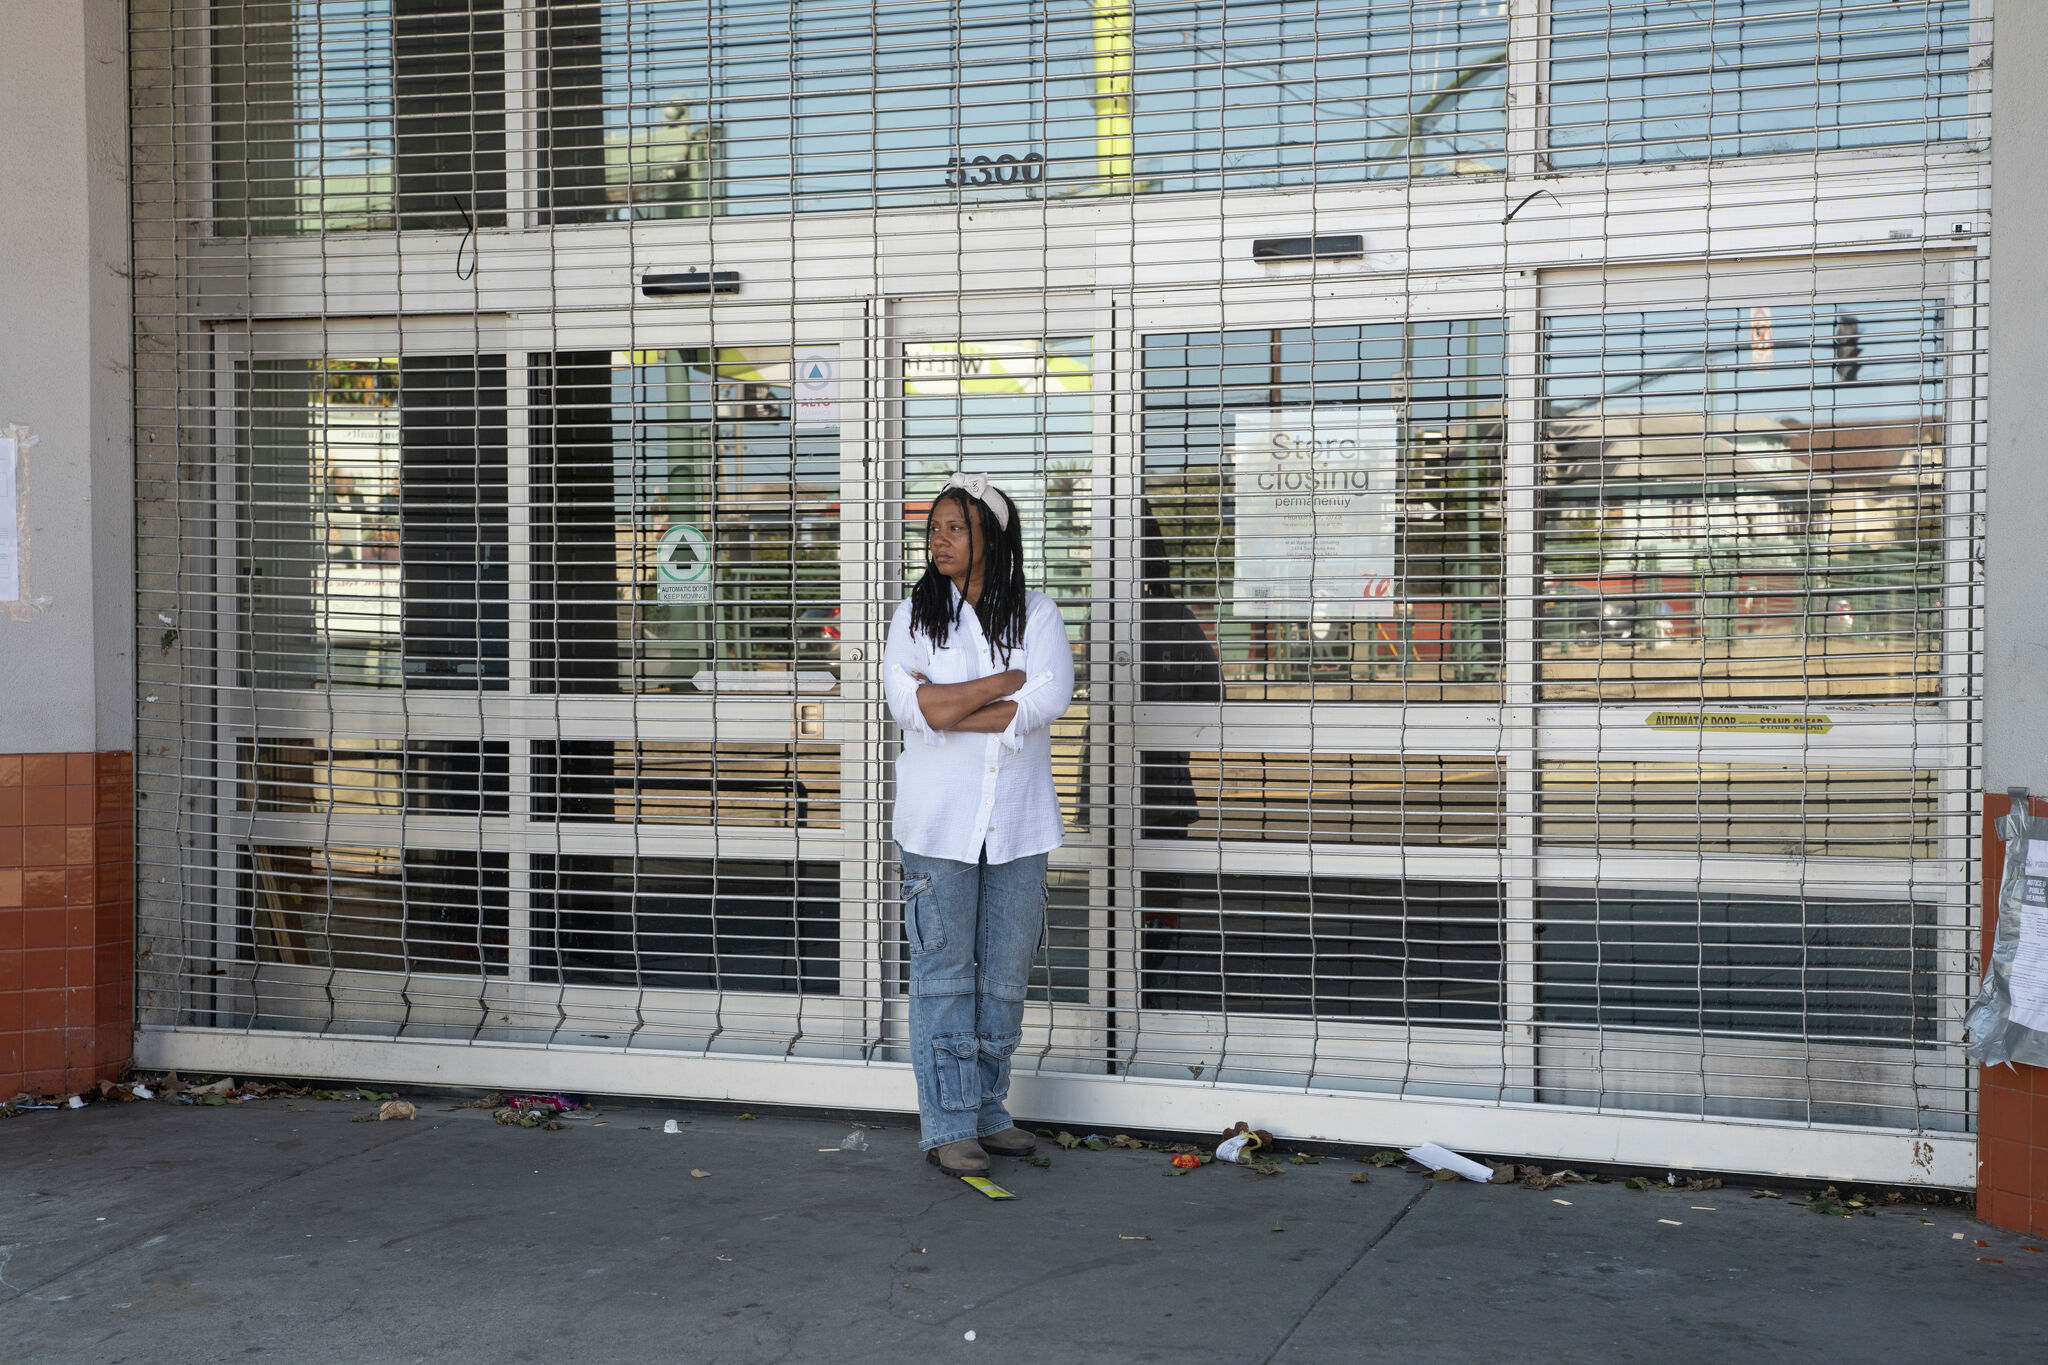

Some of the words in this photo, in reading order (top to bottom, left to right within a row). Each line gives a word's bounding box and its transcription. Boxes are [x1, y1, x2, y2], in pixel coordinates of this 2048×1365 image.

[944, 152, 1046, 188] 5300
[1273, 433, 1355, 460] Store
[1257, 464, 1369, 496] closing
[1655, 715, 1709, 728] AUTOMATC
[1711, 716, 1737, 729] DOOR
[1760, 717, 1790, 730] STAND
[1793, 718, 1824, 731] CLEAR
